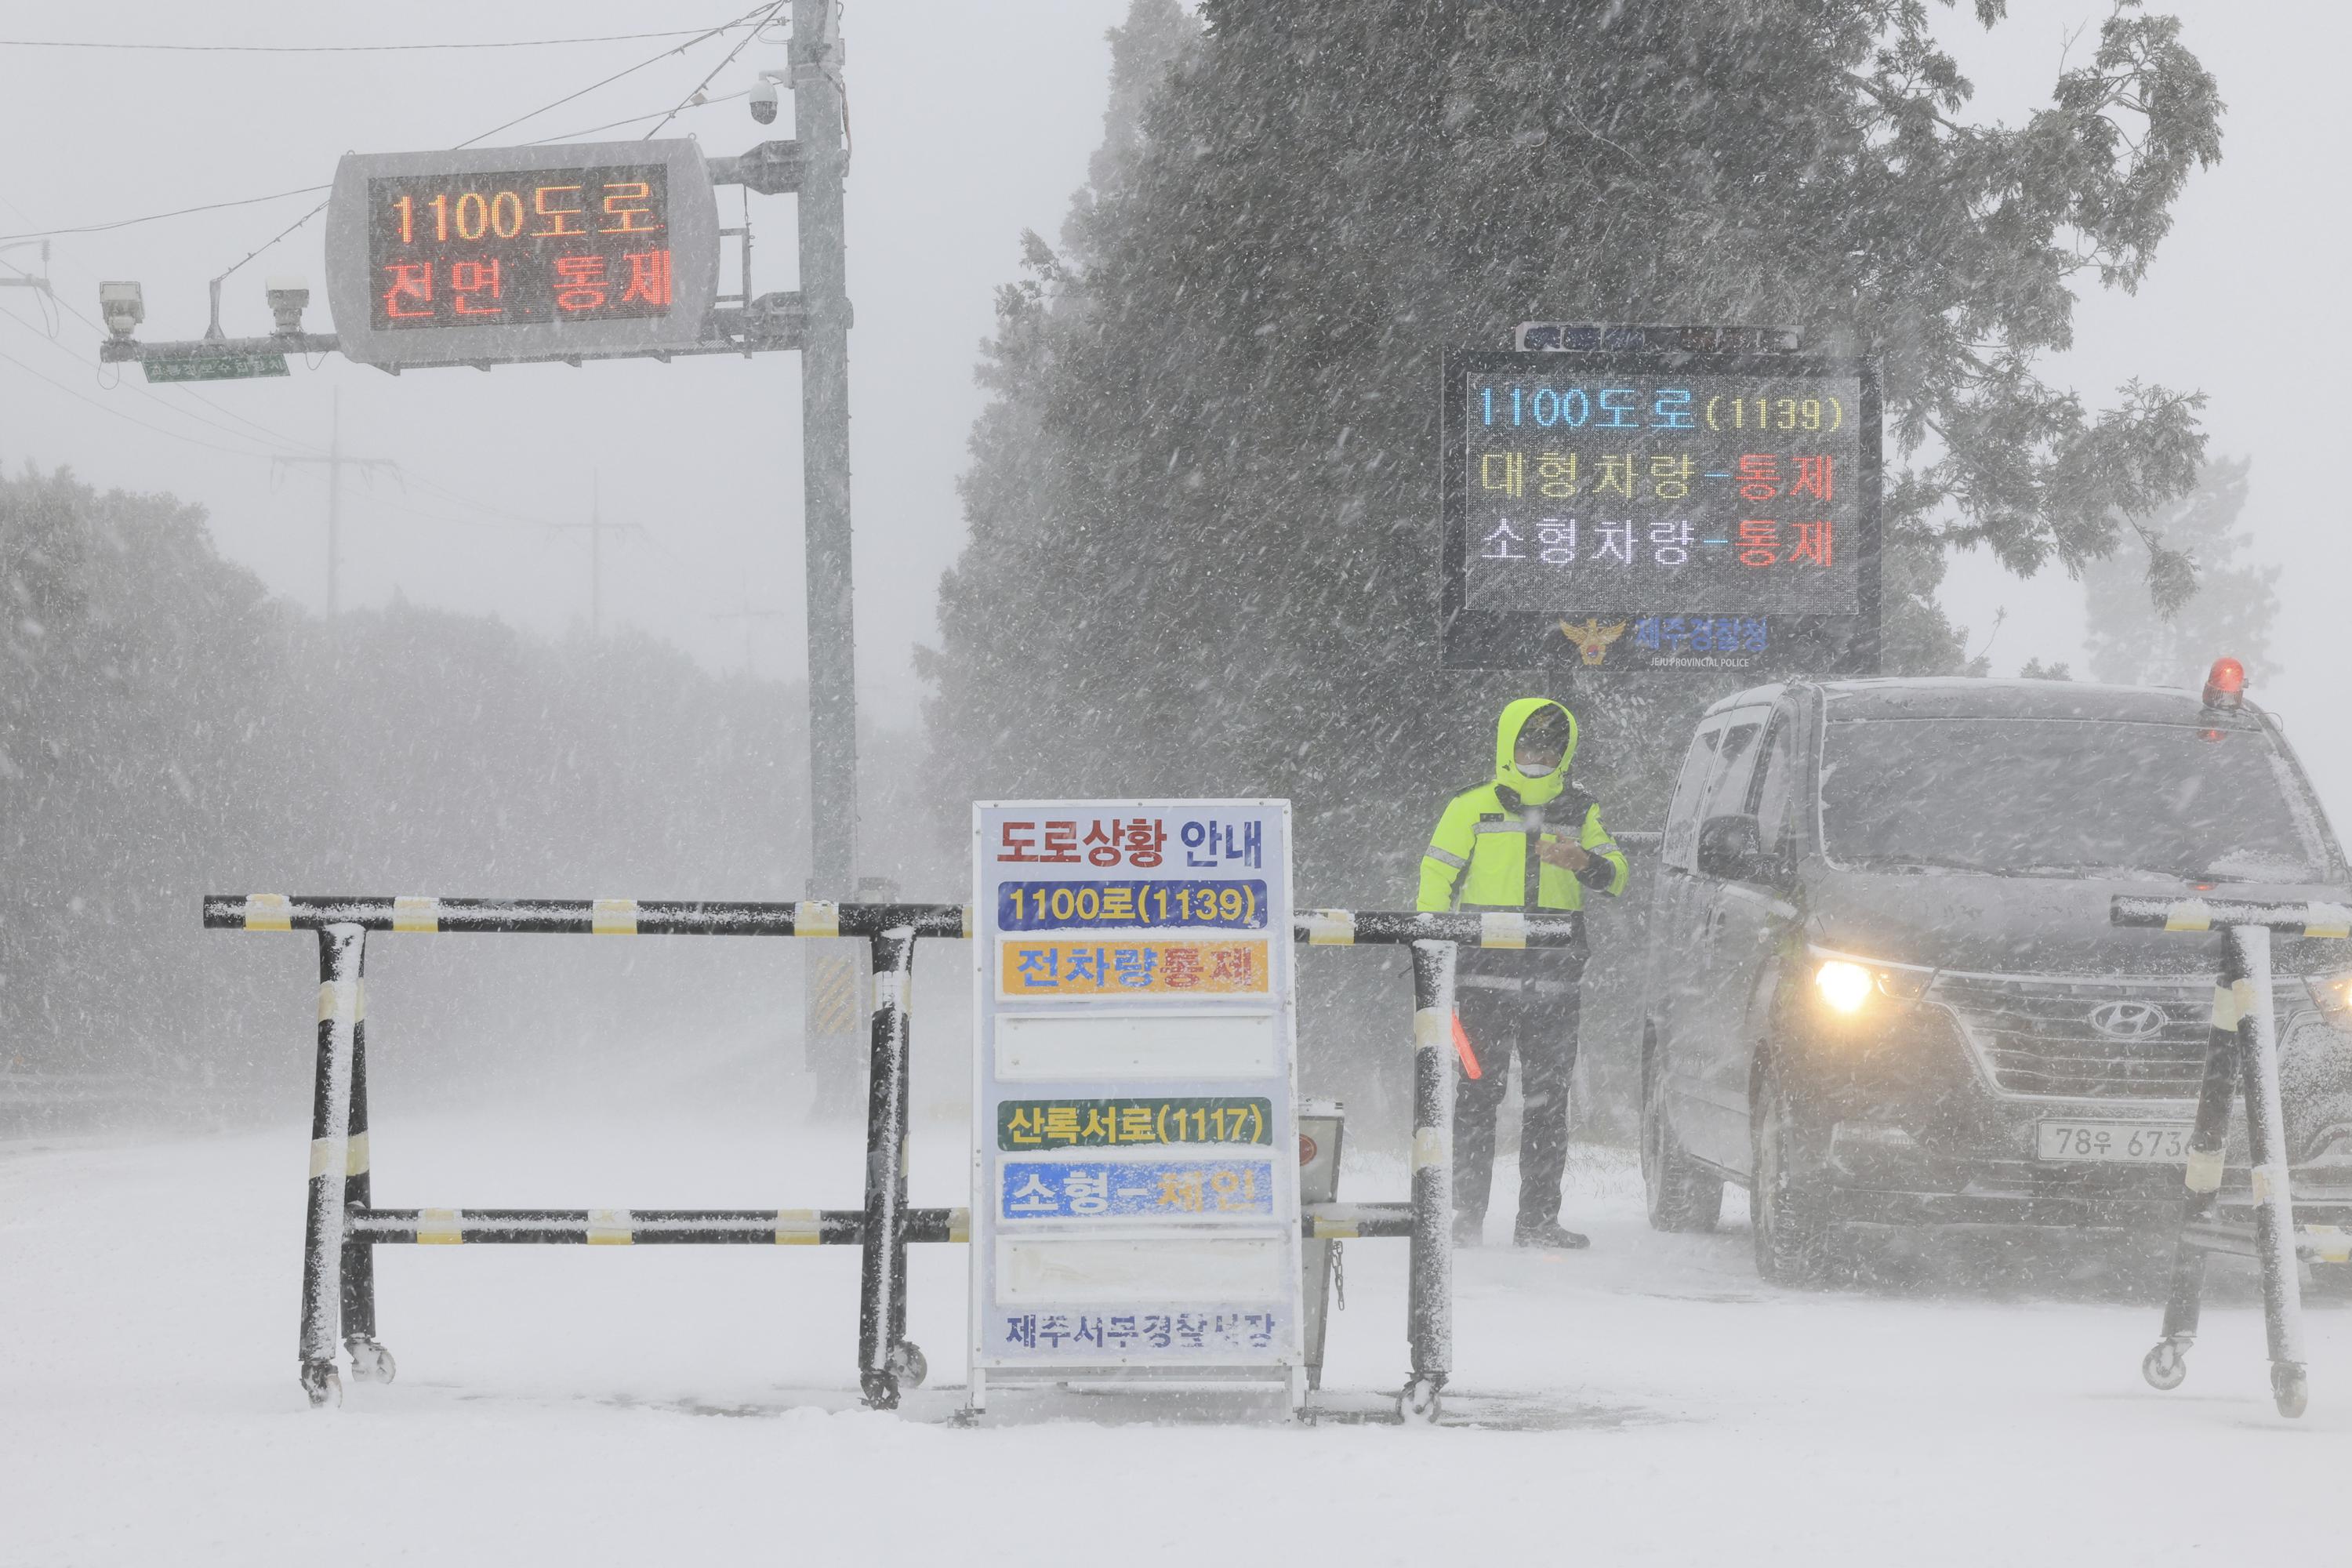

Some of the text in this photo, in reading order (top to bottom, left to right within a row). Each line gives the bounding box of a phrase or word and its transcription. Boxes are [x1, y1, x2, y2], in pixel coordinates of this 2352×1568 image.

[393, 182, 655, 243] 1100도로
[383, 249, 670, 317] 전면 통제
[1481, 387, 1842, 433] 1100도로(1139)
[1635, 617, 1769, 652] 제주경찰청
[1650, 657, 1749, 667] JEJU PROVINCIAL POLICE
[996, 818, 1261, 869] 도로상황 안내
[1010, 885, 1255, 923] 1100로(1139)
[1007, 1104, 1263, 1144] 산록서로(1117)
[2056, 1128, 2111, 1155] 78우
